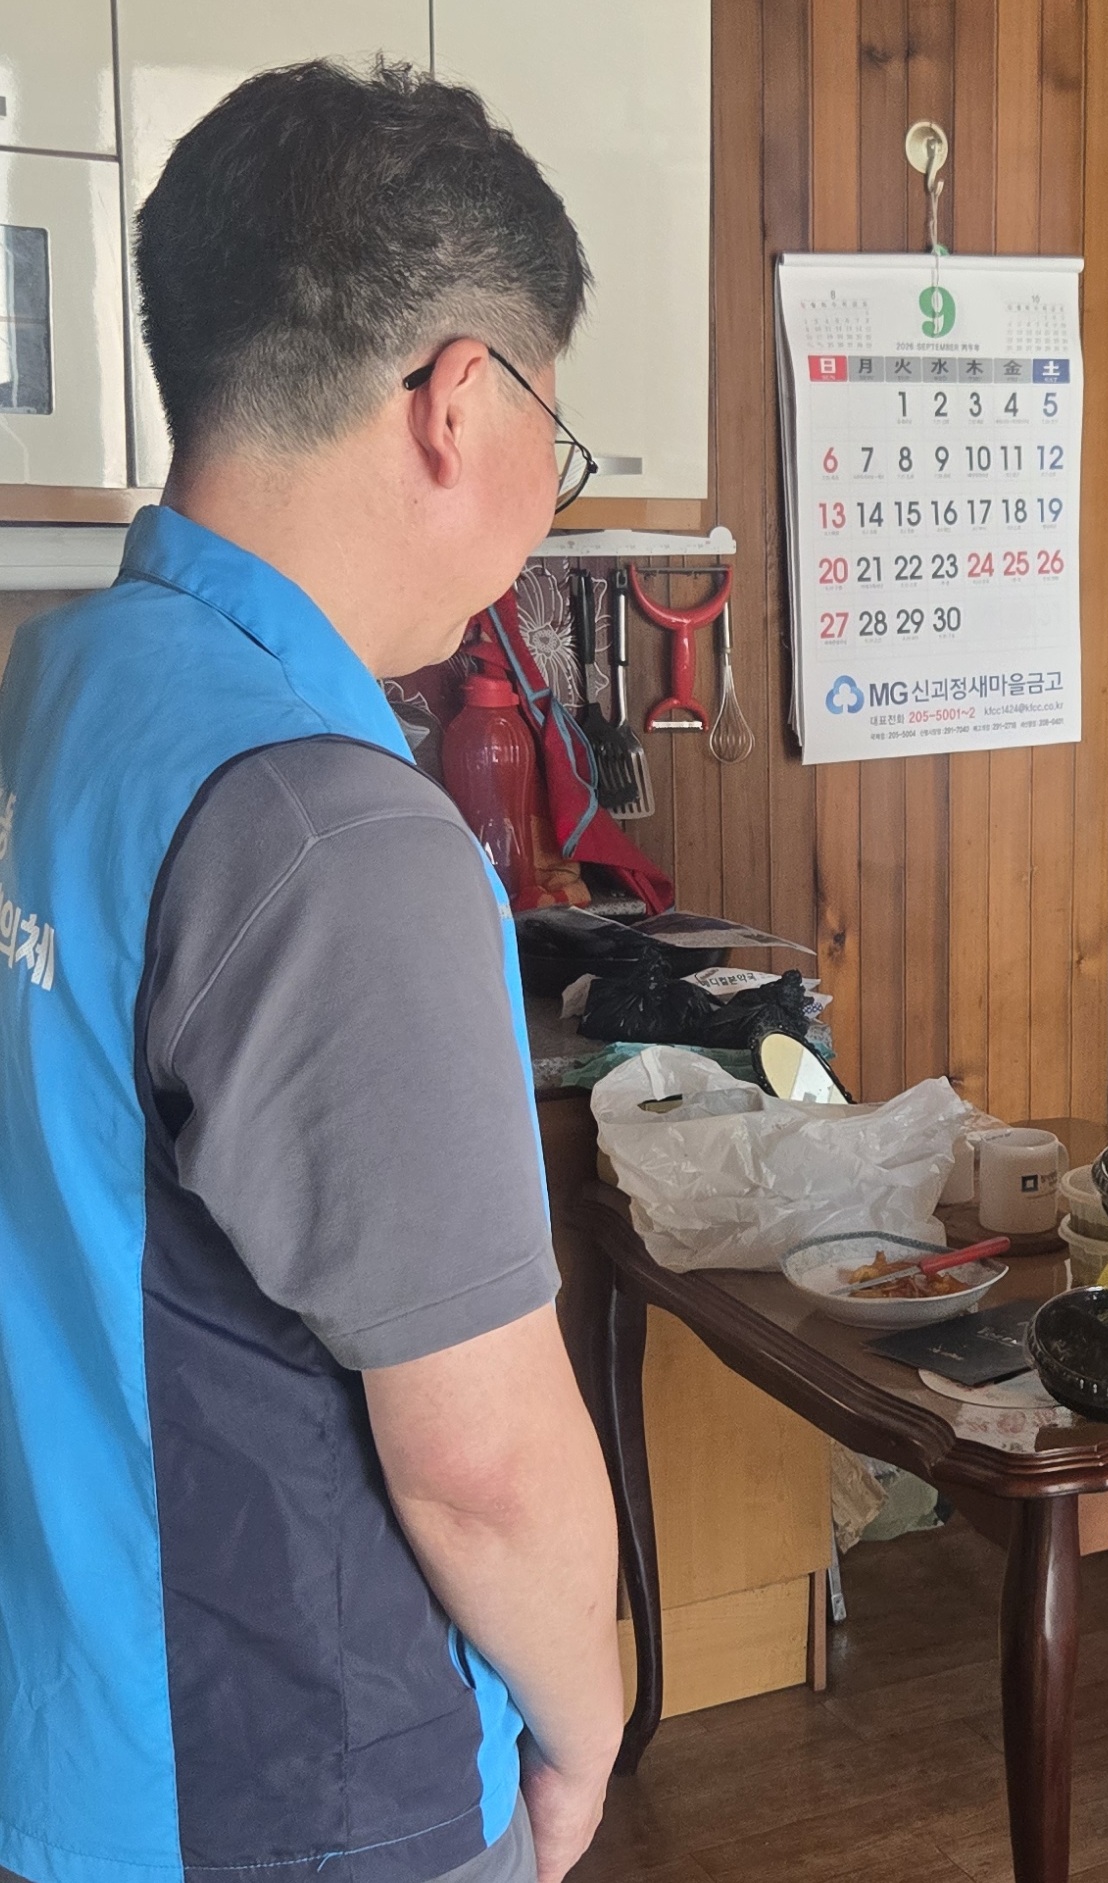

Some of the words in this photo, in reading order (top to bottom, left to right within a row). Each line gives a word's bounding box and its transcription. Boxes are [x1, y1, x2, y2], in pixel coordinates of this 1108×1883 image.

[919, 286, 956, 338] 9
[896, 342, 914, 351] 2026
[917, 343, 959, 351] SEPTEMBER
[820, 358, 836, 374] 日
[859, 358, 873, 374] 月
[894, 358, 912, 374] 火
[931, 358, 949, 375] 水
[966, 360, 983, 375] 木
[1003, 360, 1022, 376] 金
[1042, 360, 1060, 376] 土
[898, 392, 907, 417] 1
[934, 392, 948, 417] 2
[969, 392, 982, 417] 3
[1004, 392, 1019, 417] 4
[1043, 393, 1058, 417] 5
[823, 447, 838, 473] 6
[861, 447, 874, 472] 7
[899, 446, 912, 472] 8
[935, 446, 949, 471] 9
[965, 446, 991, 471] 10
[1000, 446, 1022, 470] 11
[1037, 445, 1064, 469] 12
[819, 502, 846, 529] 13
[857, 501, 883, 527] 14
[895, 501, 921, 527] 15
[931, 500, 958, 526] 16
[967, 500, 991, 524] 17
[1002, 499, 1027, 523] 18
[1037, 498, 1063, 523] 19
[819, 558, 848, 584] 20
[857, 556, 881, 582] 21
[895, 555, 923, 581] 22
[932, 553, 958, 579] 23
[967, 552, 994, 578] 24
[1003, 551, 1029, 576] 25
[1037, 550, 1064, 574] 26
[821, 613, 849, 639] 27
[859, 610, 888, 636] 28
[896, 609, 924, 634] 29
[933, 607, 961, 632] 30
[870, 713, 905, 726] 대표전화
[908, 707, 976, 724] 205-5001~2
[984, 701, 1063, 716] kfcc1424@kfcc.co.kr
[0, 882, 55, 991] 의체
